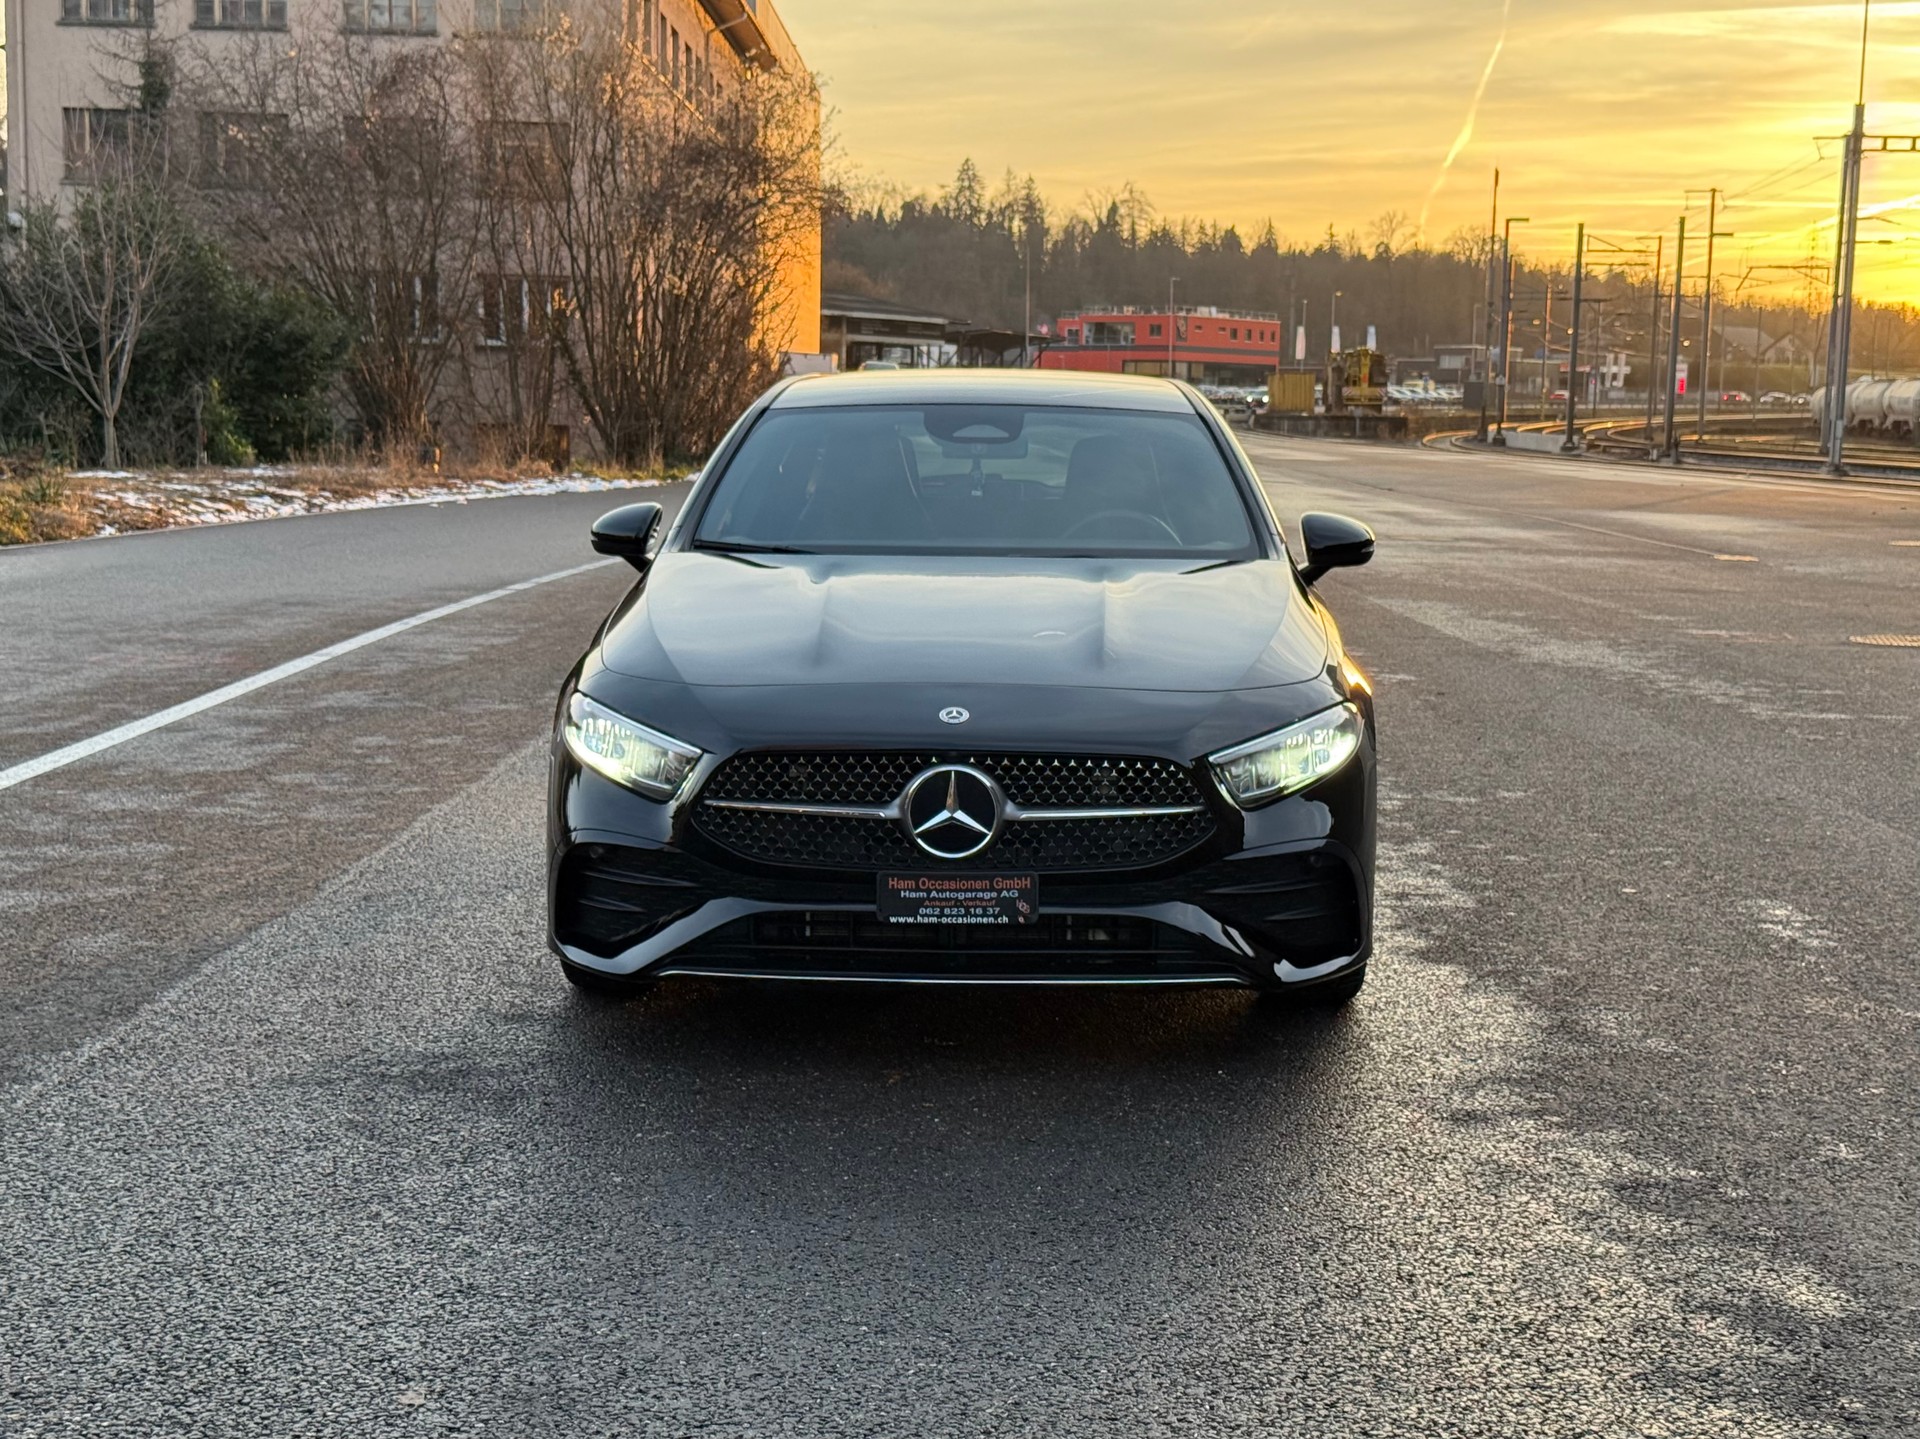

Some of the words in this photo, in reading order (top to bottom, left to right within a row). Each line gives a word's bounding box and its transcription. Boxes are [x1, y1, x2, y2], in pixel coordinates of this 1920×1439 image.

[888, 877, 915, 889] Ham
[919, 877, 990, 890] Occasionen
[993, 876, 1030, 889] GmbH
[900, 890, 926, 898] Ham
[929, 890, 997, 899] Autogarage
[1000, 889, 1019, 898] AG
[919, 907, 940, 915] 062
[944, 907, 965, 915] 823
[969, 907, 983, 915] 16
[985, 907, 1000, 915] 37
[889, 915, 1009, 924] www.ham-occasionen.ch
